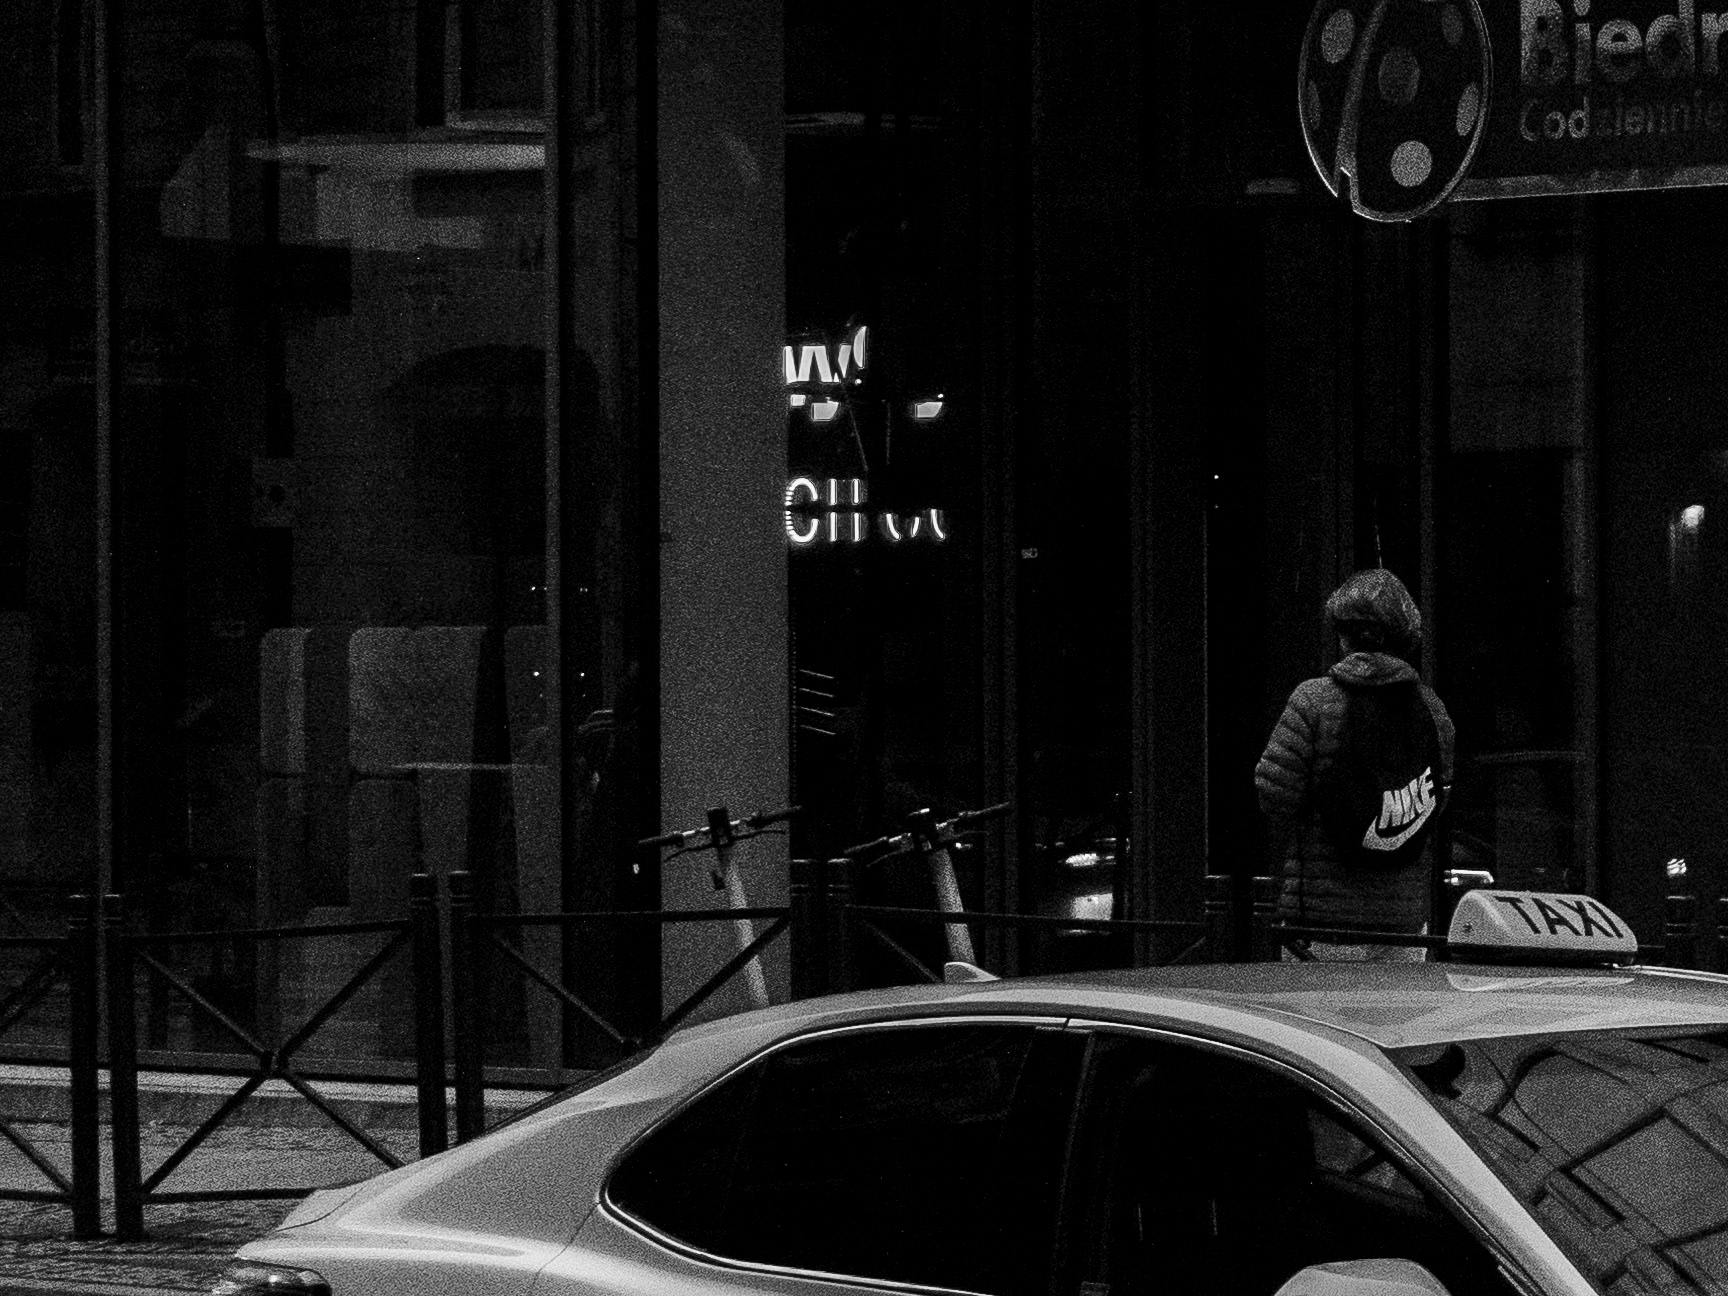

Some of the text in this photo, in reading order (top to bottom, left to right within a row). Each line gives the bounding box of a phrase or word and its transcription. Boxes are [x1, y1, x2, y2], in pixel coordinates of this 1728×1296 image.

[1518, 90, 1724, 143] Codziennie
[1379, 765, 1437, 830] NIKE
[1494, 895, 1624, 939] TAXI
